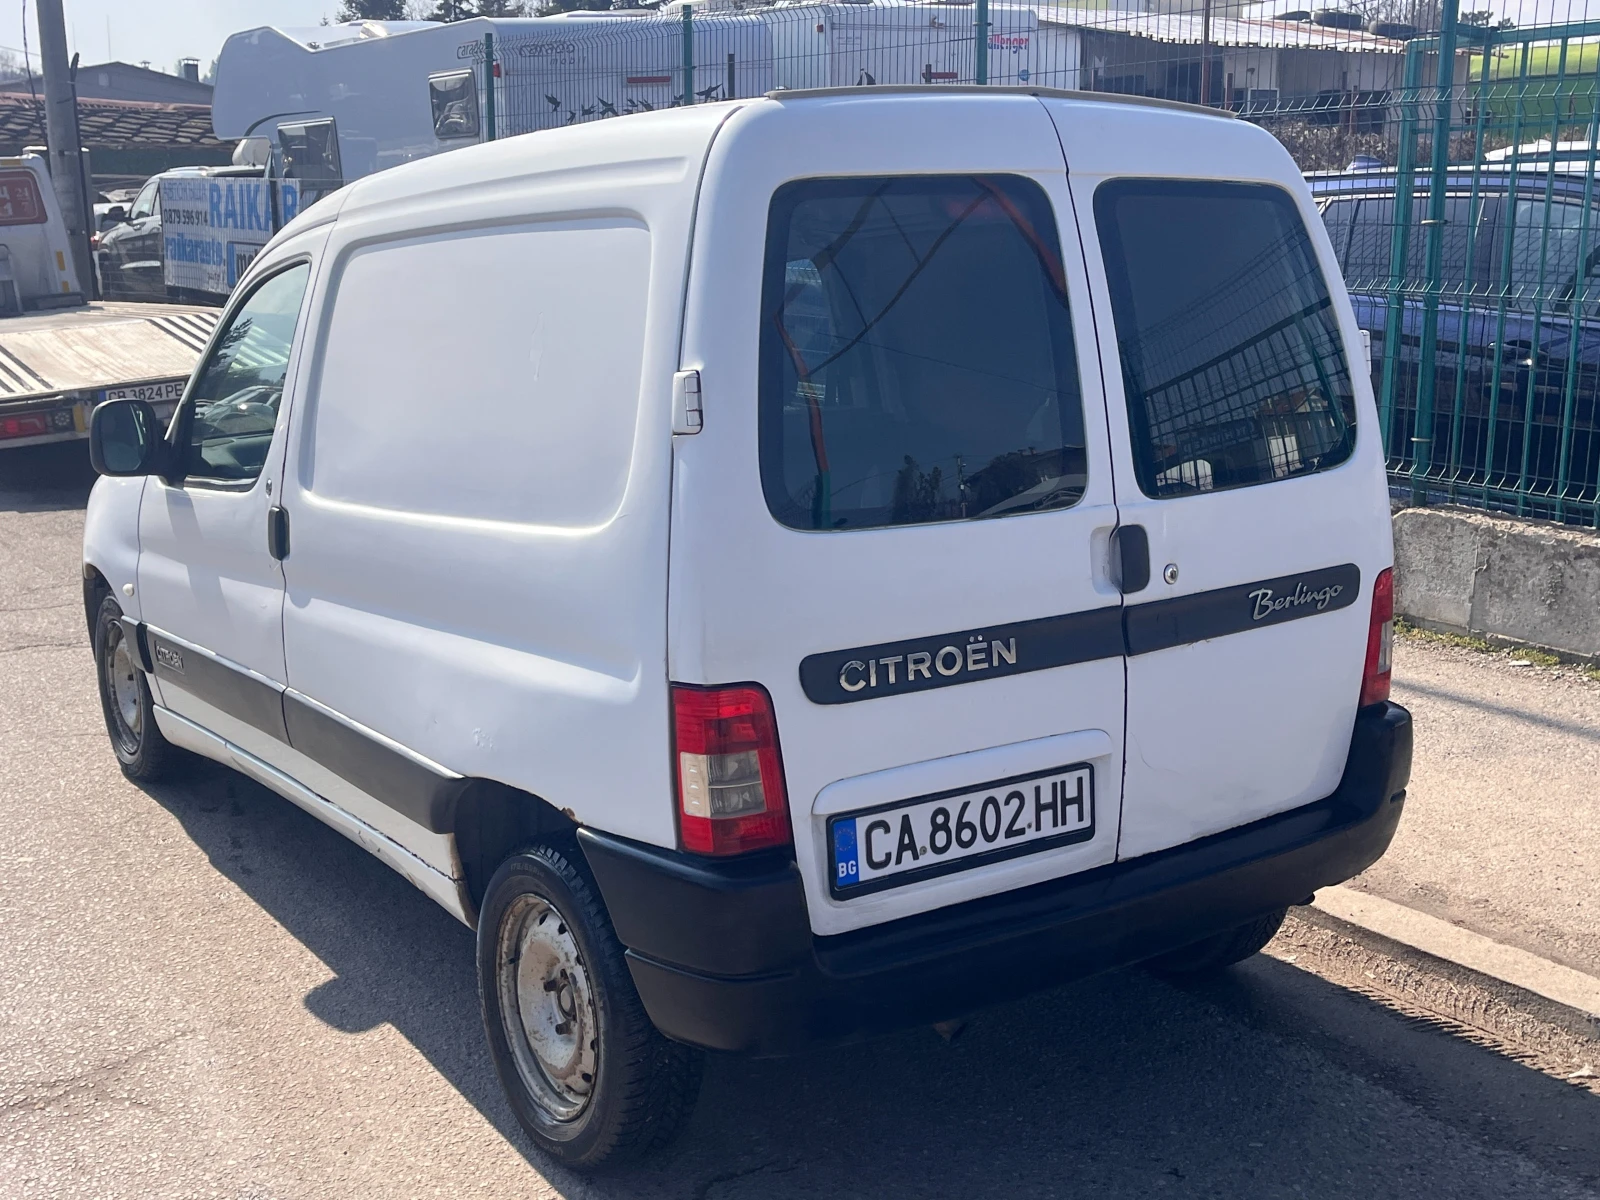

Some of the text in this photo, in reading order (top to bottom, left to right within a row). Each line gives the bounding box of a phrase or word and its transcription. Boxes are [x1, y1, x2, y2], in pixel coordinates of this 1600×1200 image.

[988, 34, 1029, 54] allenger
[1248, 582, 1344, 620] Berlingo
[839, 634, 1017, 692] CITROËN
[838, 860, 857, 878] BG
